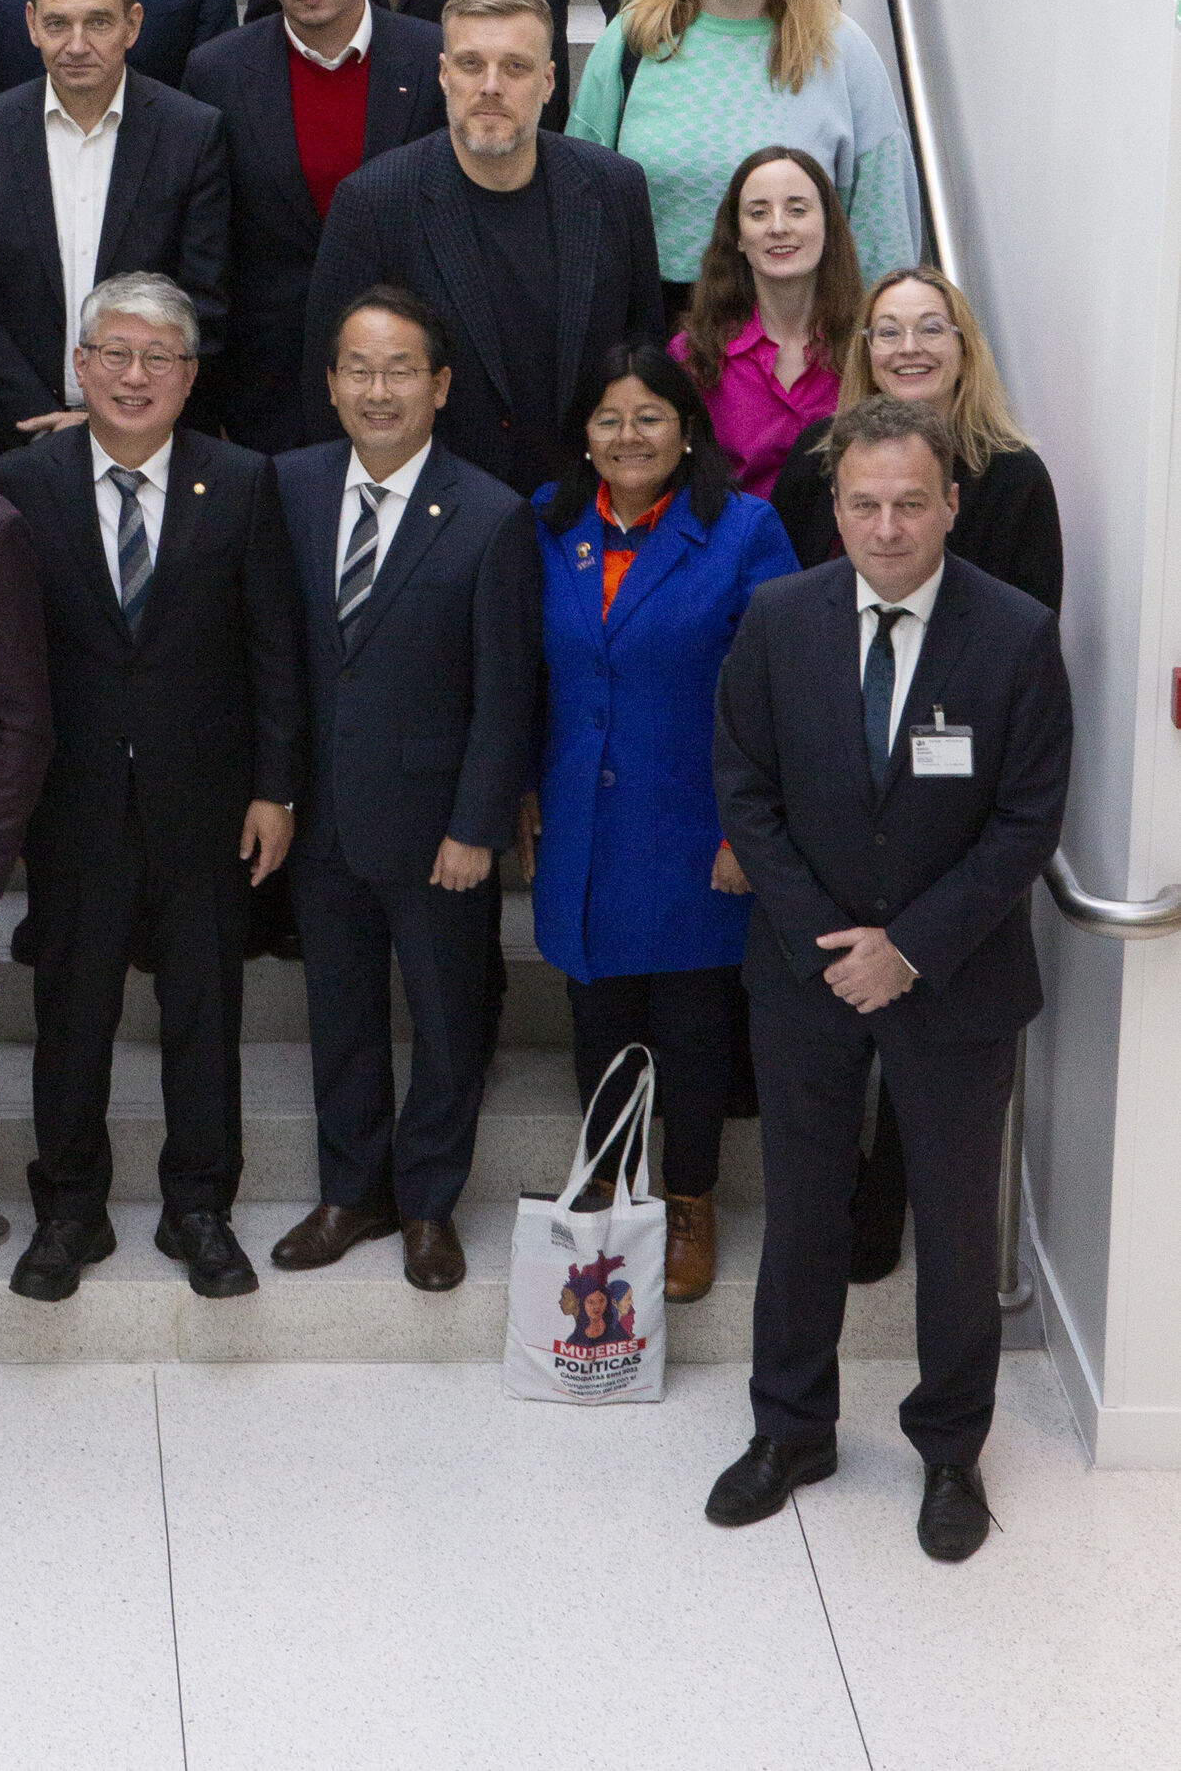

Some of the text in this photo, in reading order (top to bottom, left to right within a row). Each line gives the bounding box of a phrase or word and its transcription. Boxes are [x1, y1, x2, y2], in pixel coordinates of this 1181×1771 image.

[559, 1341, 638, 1359] MUJERES
[554, 1353, 641, 1374] POLÍTICAS
[560, 1371, 604, 1382] CANDIDATAS
